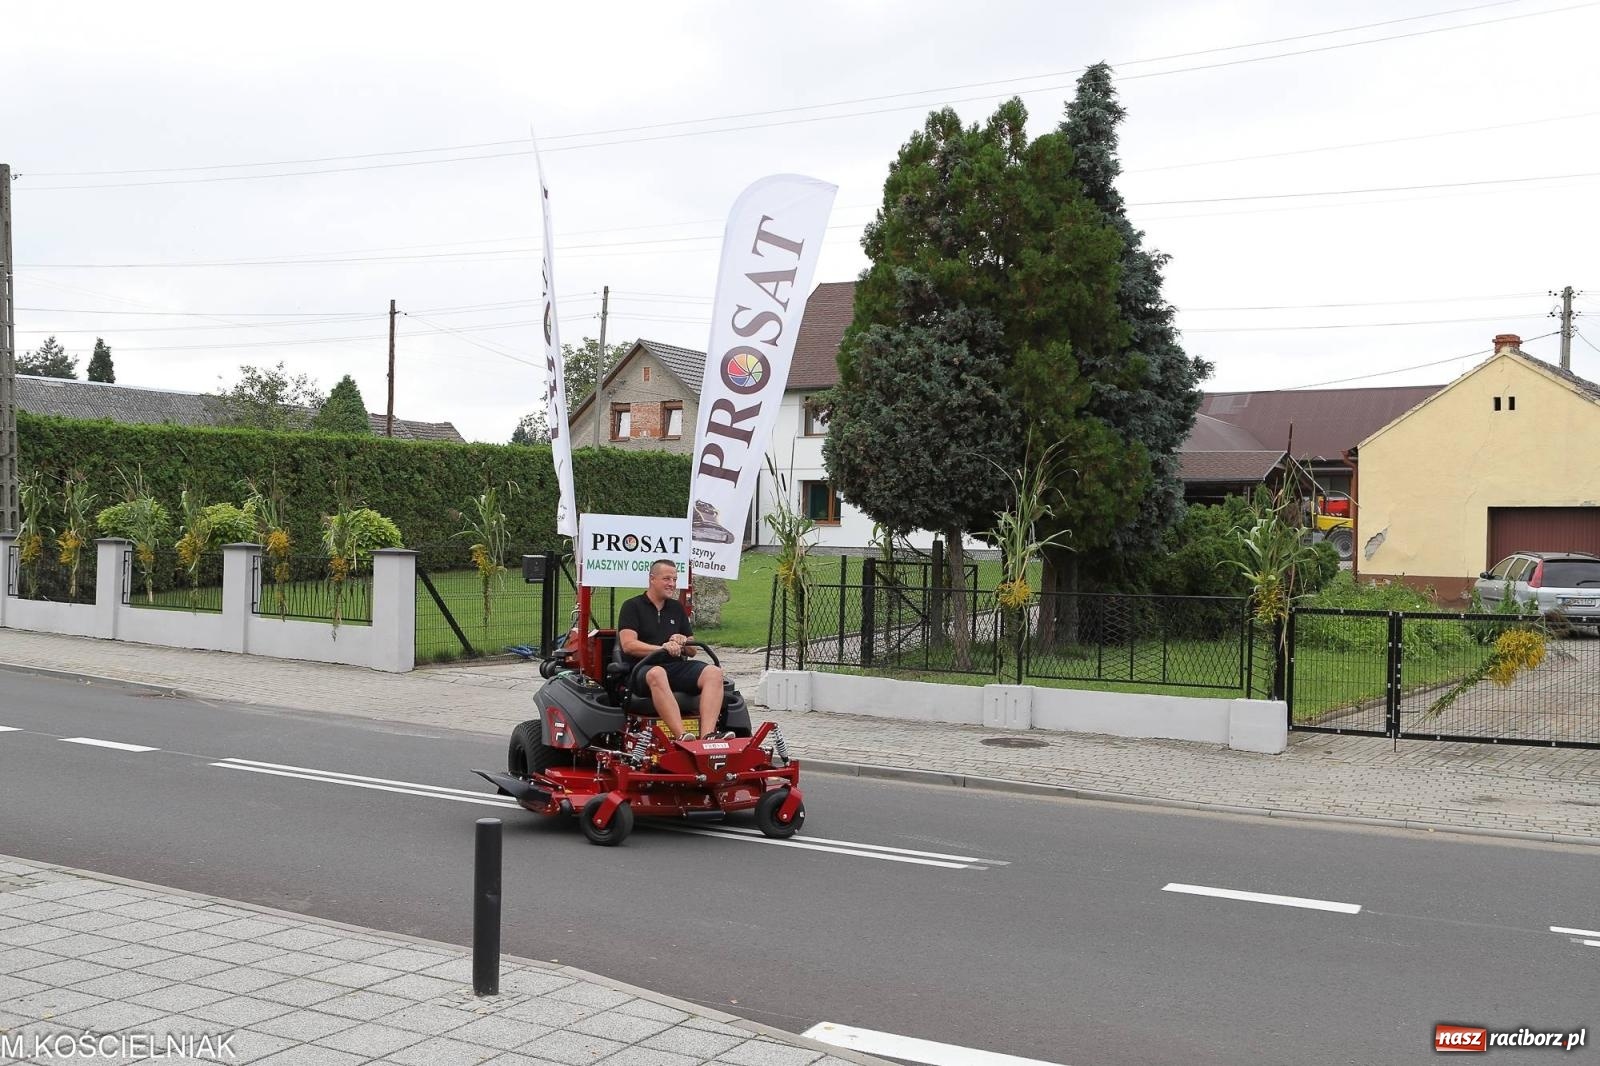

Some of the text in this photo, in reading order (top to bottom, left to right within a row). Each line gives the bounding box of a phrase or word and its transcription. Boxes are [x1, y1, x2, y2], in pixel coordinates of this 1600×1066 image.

[697, 214, 805, 489] PROSAT
[592, 533, 684, 554] PROSAT
[692, 547, 716, 561] szyny
[586, 560, 686, 573] MASZYNY OGRZE
